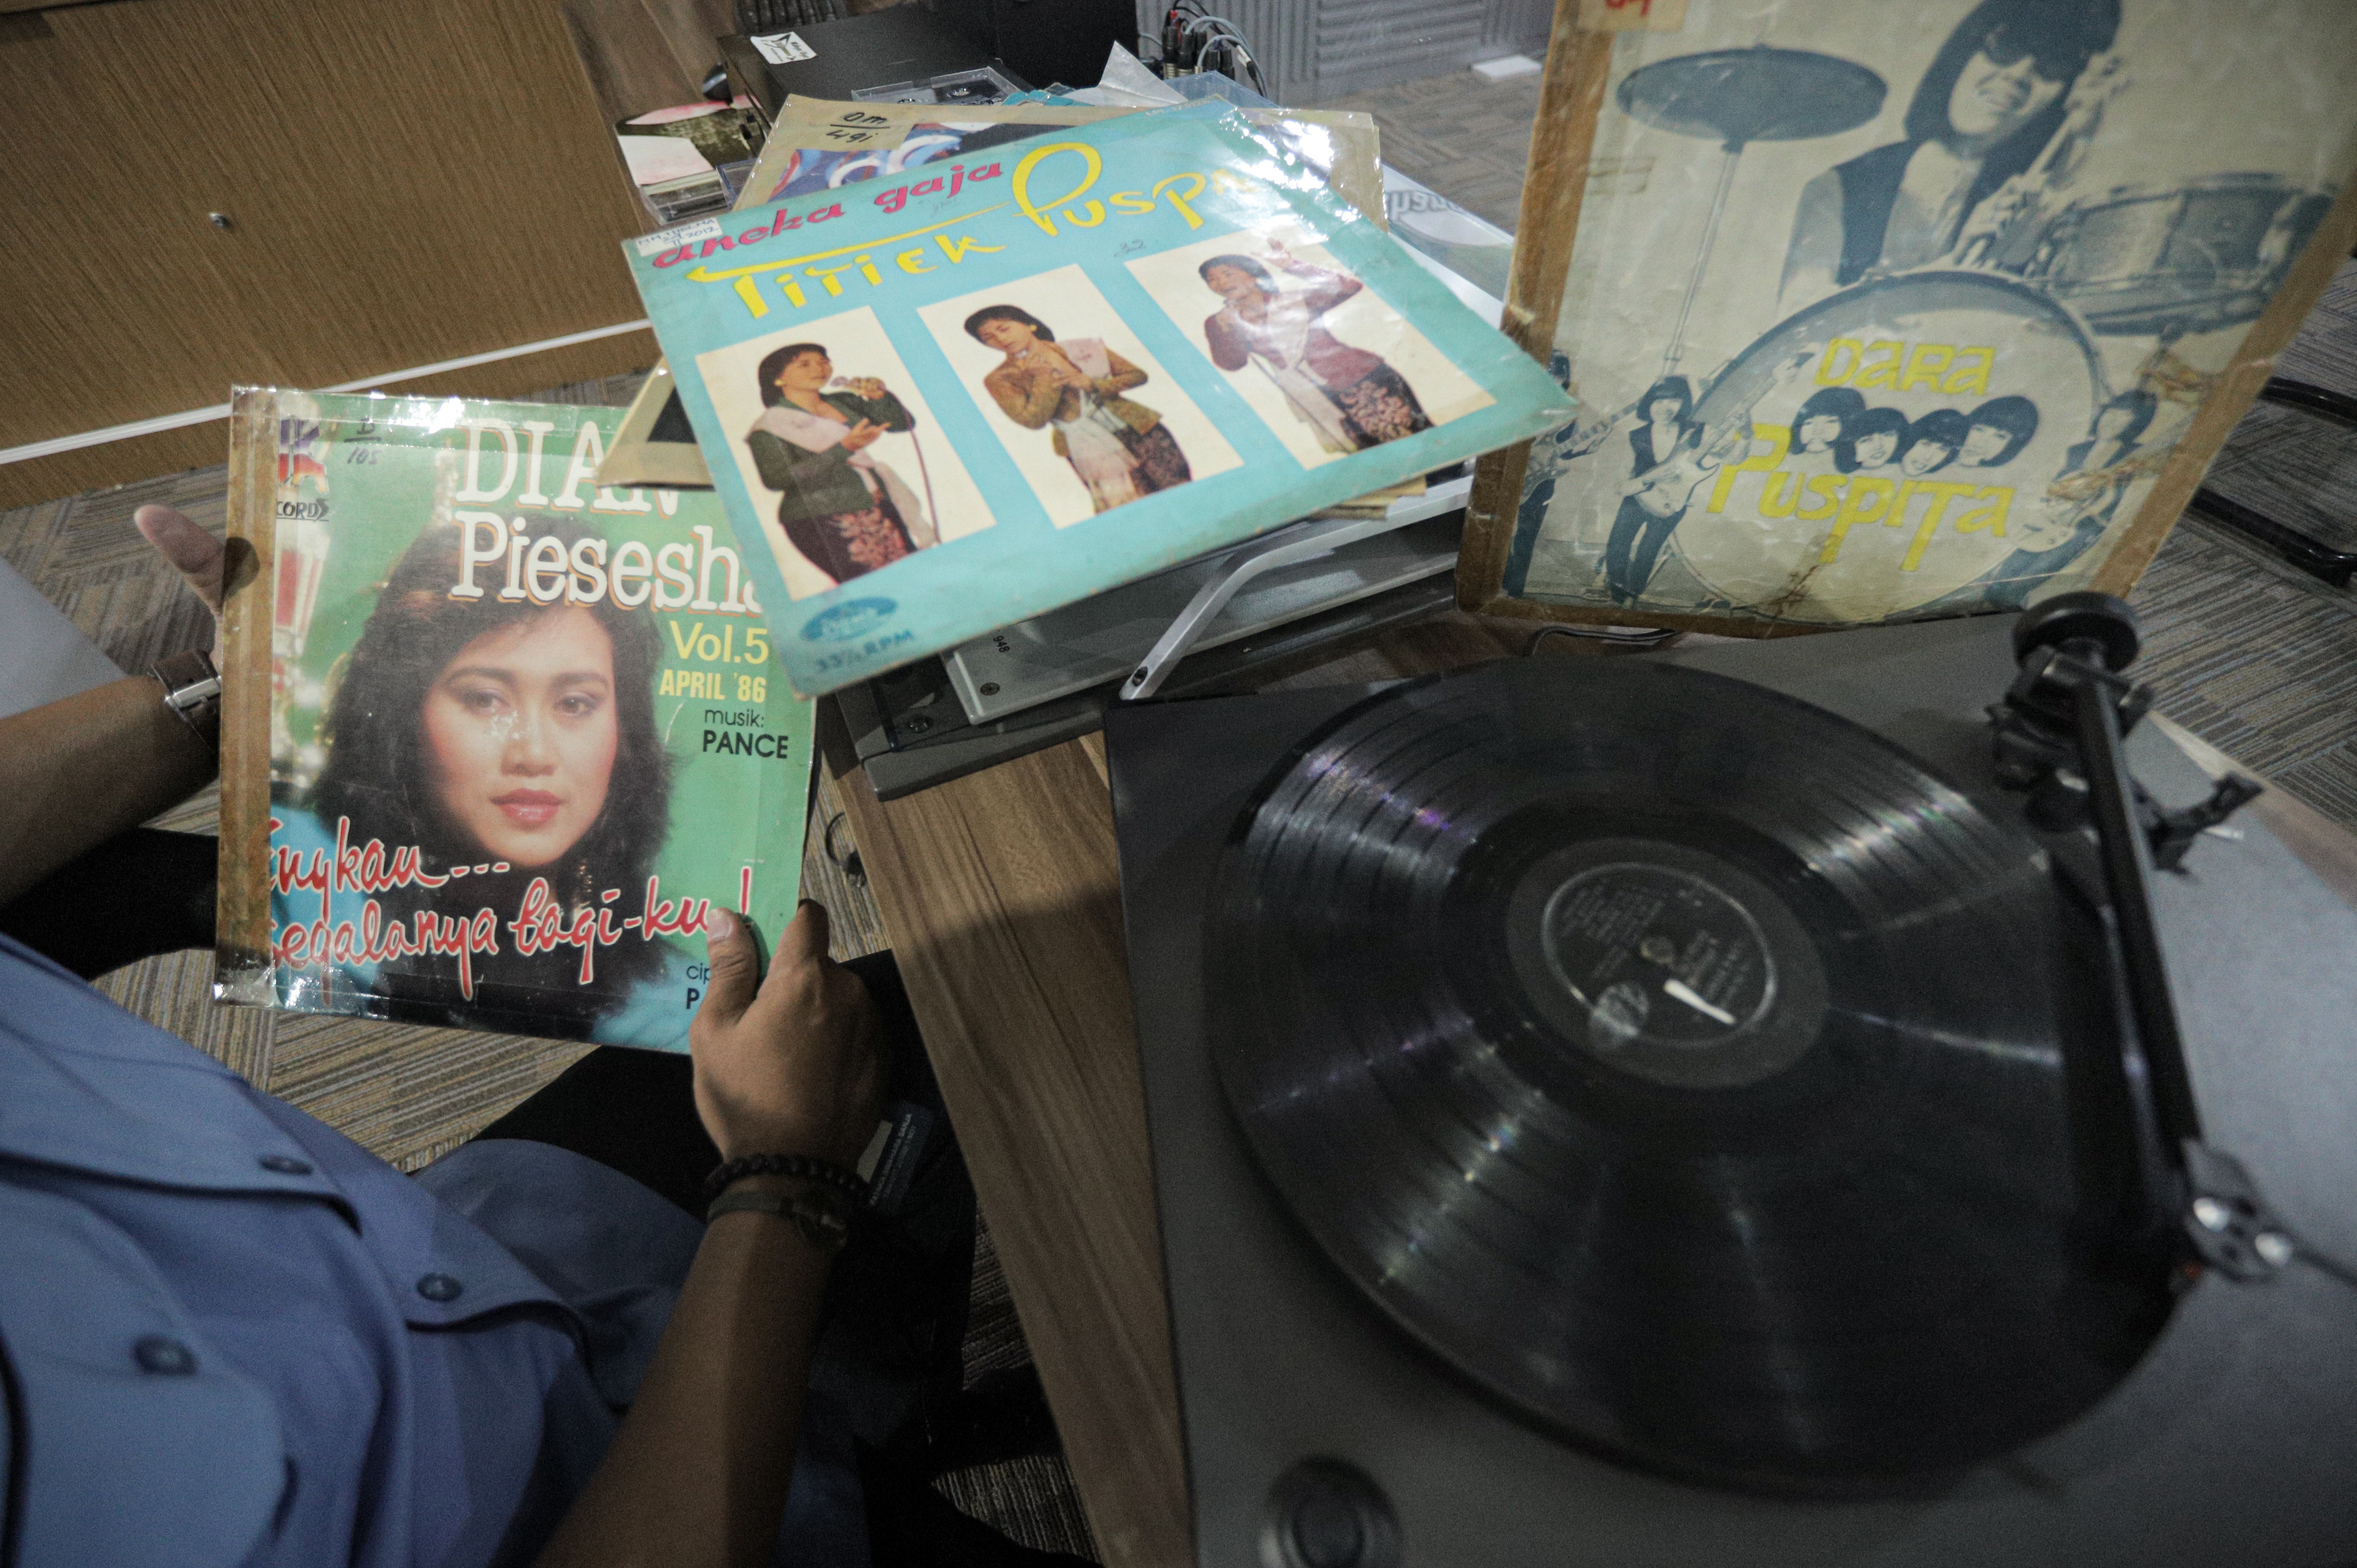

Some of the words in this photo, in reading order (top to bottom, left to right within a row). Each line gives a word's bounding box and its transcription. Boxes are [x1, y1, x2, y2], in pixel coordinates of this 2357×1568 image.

[653, 203, 845, 269] aneka
[874, 162, 1003, 214] gaja
[670, 620, 769, 664] Vol.5
[659, 669, 725, 700] APRIL
[704, 709, 765, 728] musik:
[702, 730, 788, 759] PANCE
